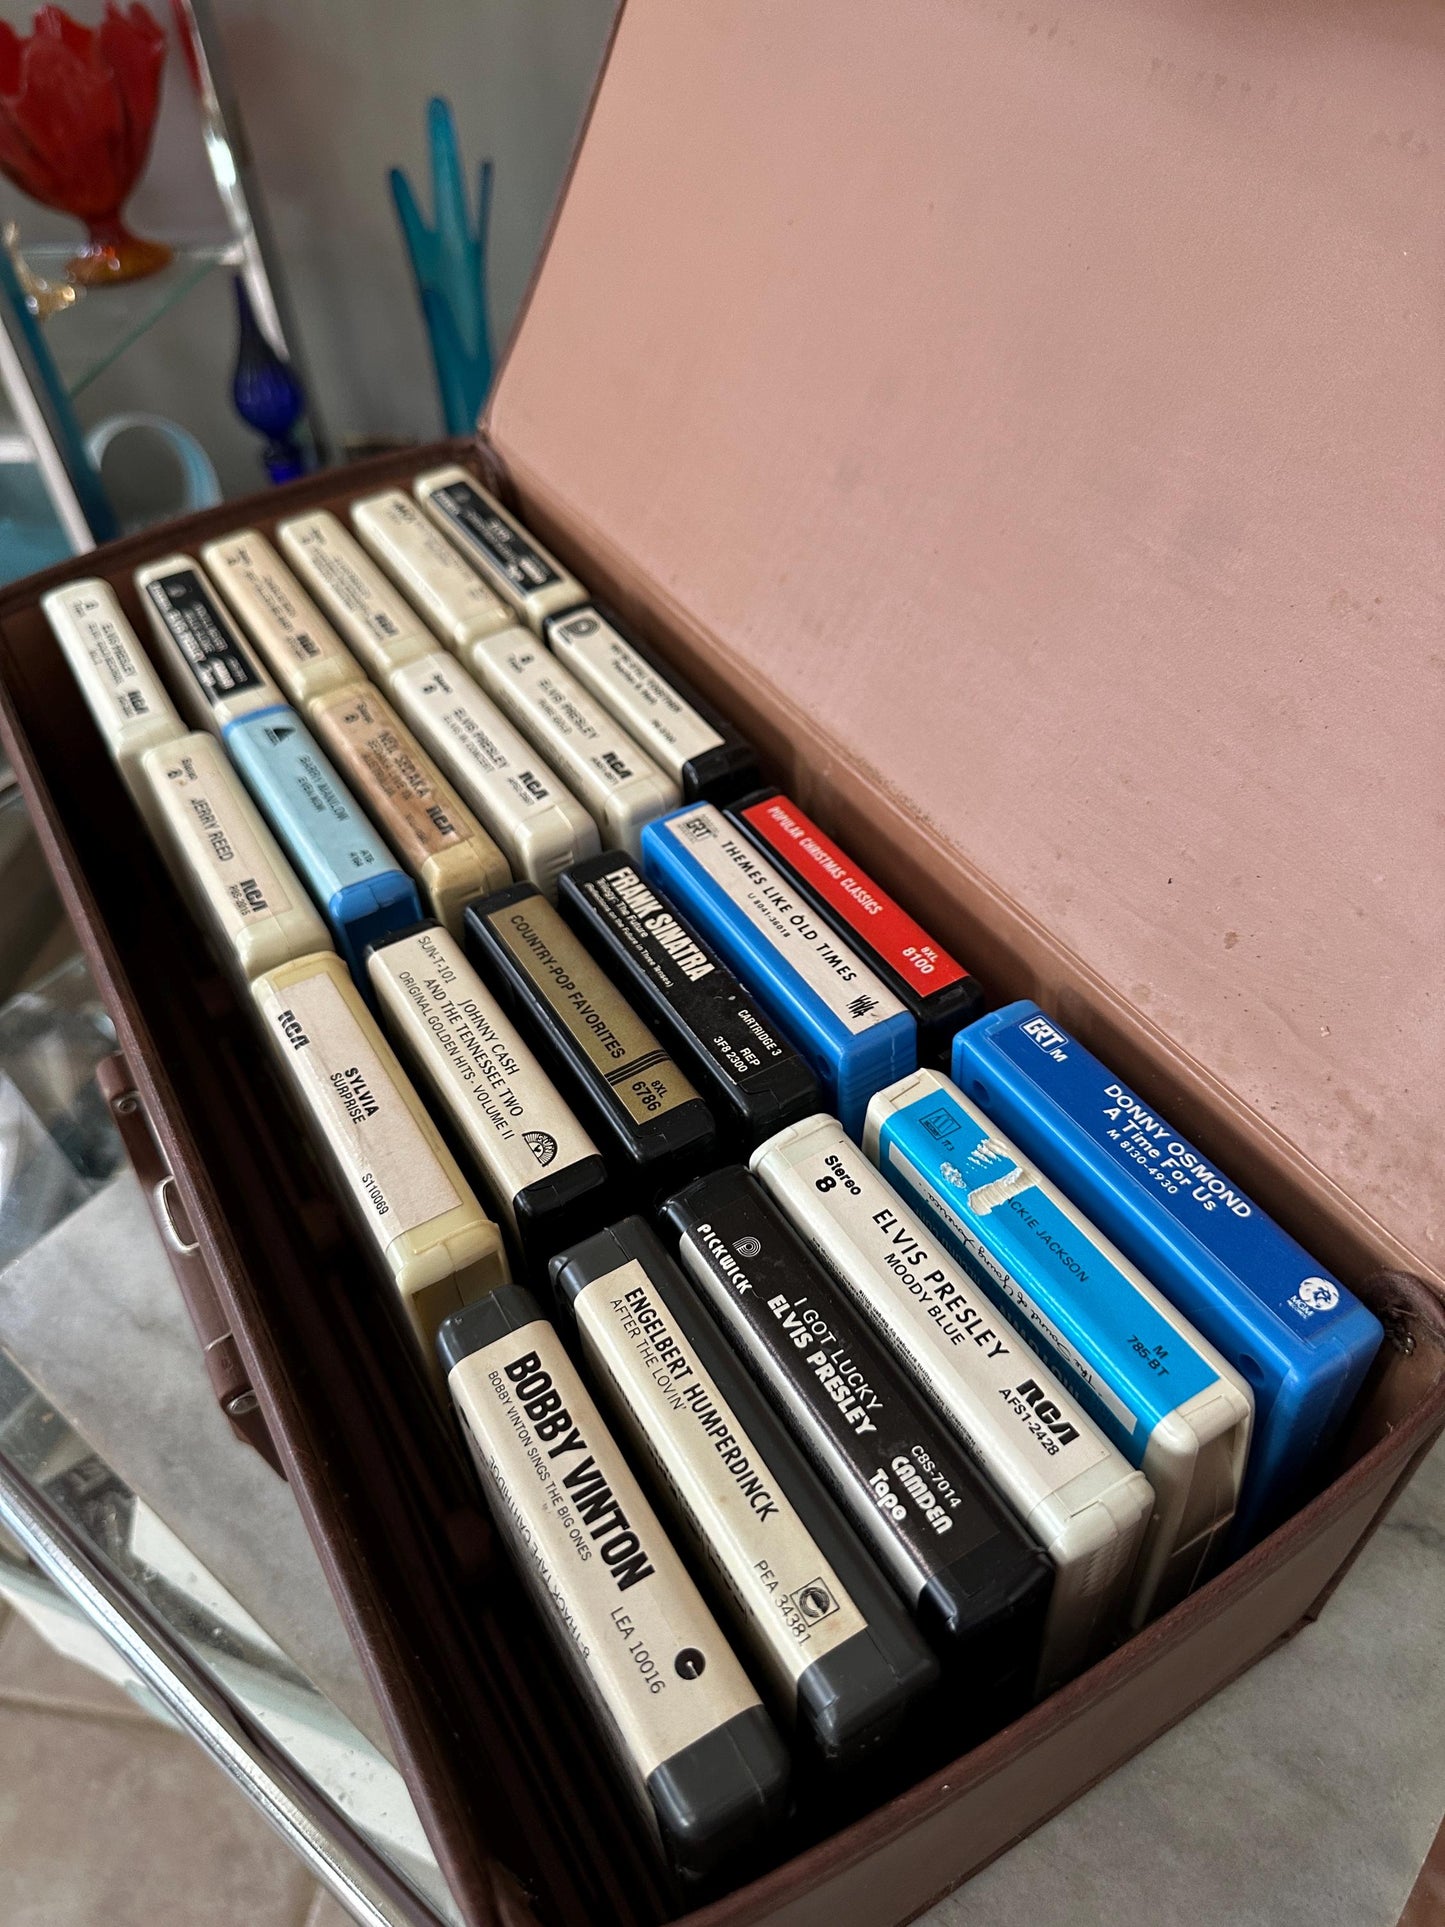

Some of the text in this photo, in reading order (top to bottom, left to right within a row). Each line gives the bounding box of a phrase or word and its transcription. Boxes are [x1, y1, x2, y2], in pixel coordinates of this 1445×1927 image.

[189, 795, 235, 863] JERRY REED
[765, 806, 884, 915] POPULAR CHRISTMAS CLASSICS
[238, 877, 268, 913] RCA
[602, 865, 665, 918] FRANK
[641, 911, 717, 982] SINATRA
[613, 901, 632, 916] The
[624, 914, 650, 938] Future
[718, 840, 858, 983] THEMES LIKE OLD TIMES
[416, 935, 458, 984] SUN-T-101
[508, 913, 627, 1060] COUNTRY-POP FAVORITES
[612, 918, 626, 928] the
[619, 926, 640, 945] Future
[638, 949, 657, 966] Three
[650, 964, 675, 988] Tenses)
[900, 945, 936, 975] 8100
[919, 945, 939, 963] 8XL
[275, 1009, 311, 1051] RCA
[397, 970, 435, 1016] ORIGINAL
[426, 1014, 461, 1057] GOLDEN
[471, 1084, 509, 1130] VOLUME
[422, 976, 525, 1118] AND THE TENNESSEE TWO
[457, 997, 521, 1076] JOHNNY CASH
[712, 1034, 749, 1074] 3F8 2300
[736, 1008, 777, 1051] CARTRIDGE
[739, 1046, 761, 1069] REP
[1021, 1016, 1066, 1050] GRT
[1048, 1048, 1068, 1063] M
[328, 1071, 367, 1125] SURPRISE
[342, 1066, 382, 1117] SYLVIA
[630, 1079, 662, 1113] 6786
[649, 1078, 669, 1099] 8XL
[812, 1174, 839, 1195] 8
[821, 1154, 866, 1197] Stereo
[1102, 1083, 1255, 1221] DONNY OSMOND
[1102, 1103, 1221, 1212] A Time For Us
[1105, 1127, 1180, 1196] M 8130-4930
[358, 1171, 390, 1217] S110069
[695, 1222, 753, 1295] PICKWICK
[1004, 1195, 1091, 1284] ACKIE JACKSON
[870, 1208, 1010, 1363] ELVIS PRESLEY
[882, 1251, 966, 1347] MOODY BLUE
[1288, 1293, 1315, 1318] MGM
[608, 1297, 643, 1341] AFTER
[634, 1339, 659, 1369] THE
[651, 1366, 688, 1415] LOVIN'
[765, 1293, 815, 1351] ELVIS
[804, 1349, 878, 1440] PRESLEY
[800, 1307, 835, 1346] GOT
[829, 1347, 884, 1414] LUCKY
[1123, 1333, 1170, 1380] 785-BT
[1150, 1343, 1169, 1360] M
[622, 1286, 693, 1383] ENGELBERT
[680, 1381, 780, 1524] HUMPERDINCK
[996, 1385, 1061, 1458] AFS1-2428
[1014, 1377, 1081, 1447] RCA
[486, 1369, 594, 1563] BOBBY VINTON SINGS THE BIG ONES
[499, 1350, 588, 1463] BOBBY
[556, 1454, 660, 1593] VINTON
[860, 1469, 911, 1526] Tape
[886, 1452, 955, 1536] CAMDEN
[908, 1443, 962, 1509] C8S-7014
[752, 1558, 813, 1647] PEA 34381
[608, 1606, 667, 1696] LEA 10016
